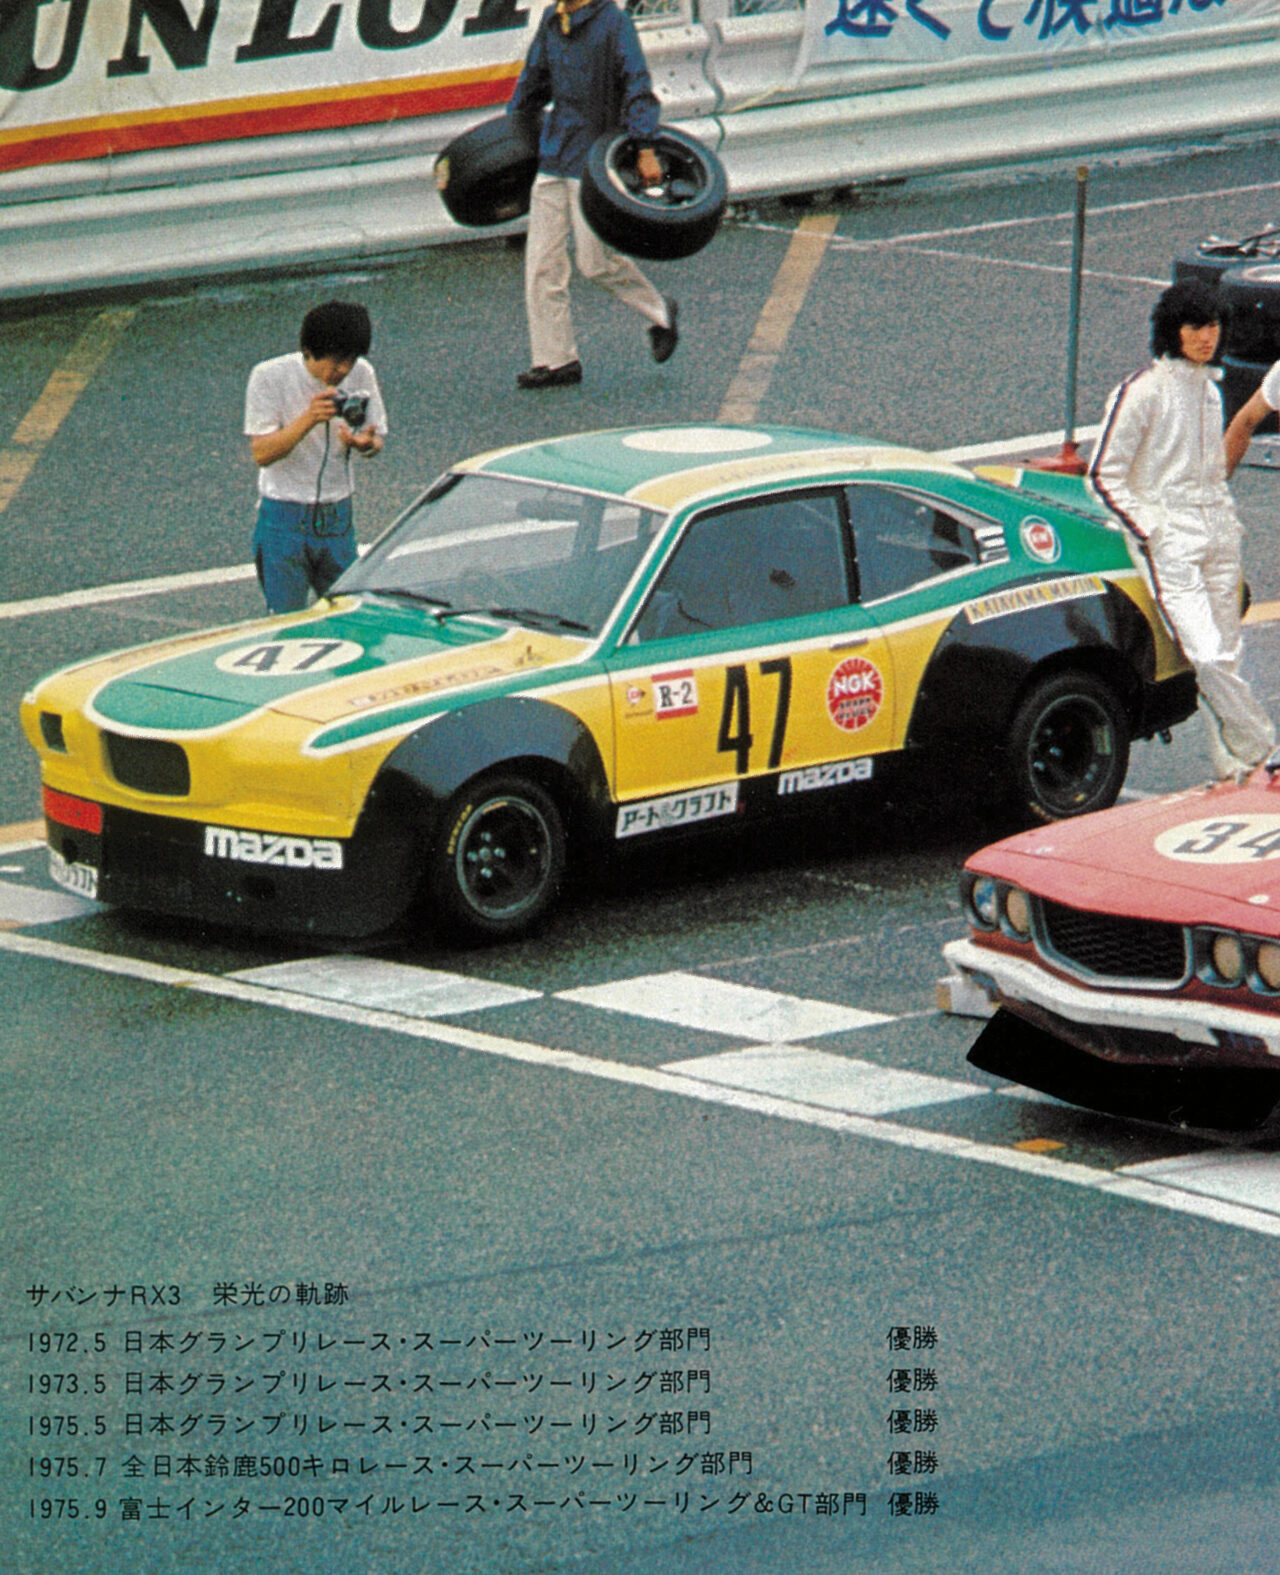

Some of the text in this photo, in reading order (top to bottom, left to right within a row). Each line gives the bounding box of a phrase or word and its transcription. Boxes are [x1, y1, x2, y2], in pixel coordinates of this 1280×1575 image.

[232, 642, 342, 672] 47
[659, 681, 693, 708] R-2
[834, 671, 876, 698] NGK
[717, 656, 793, 776] 47
